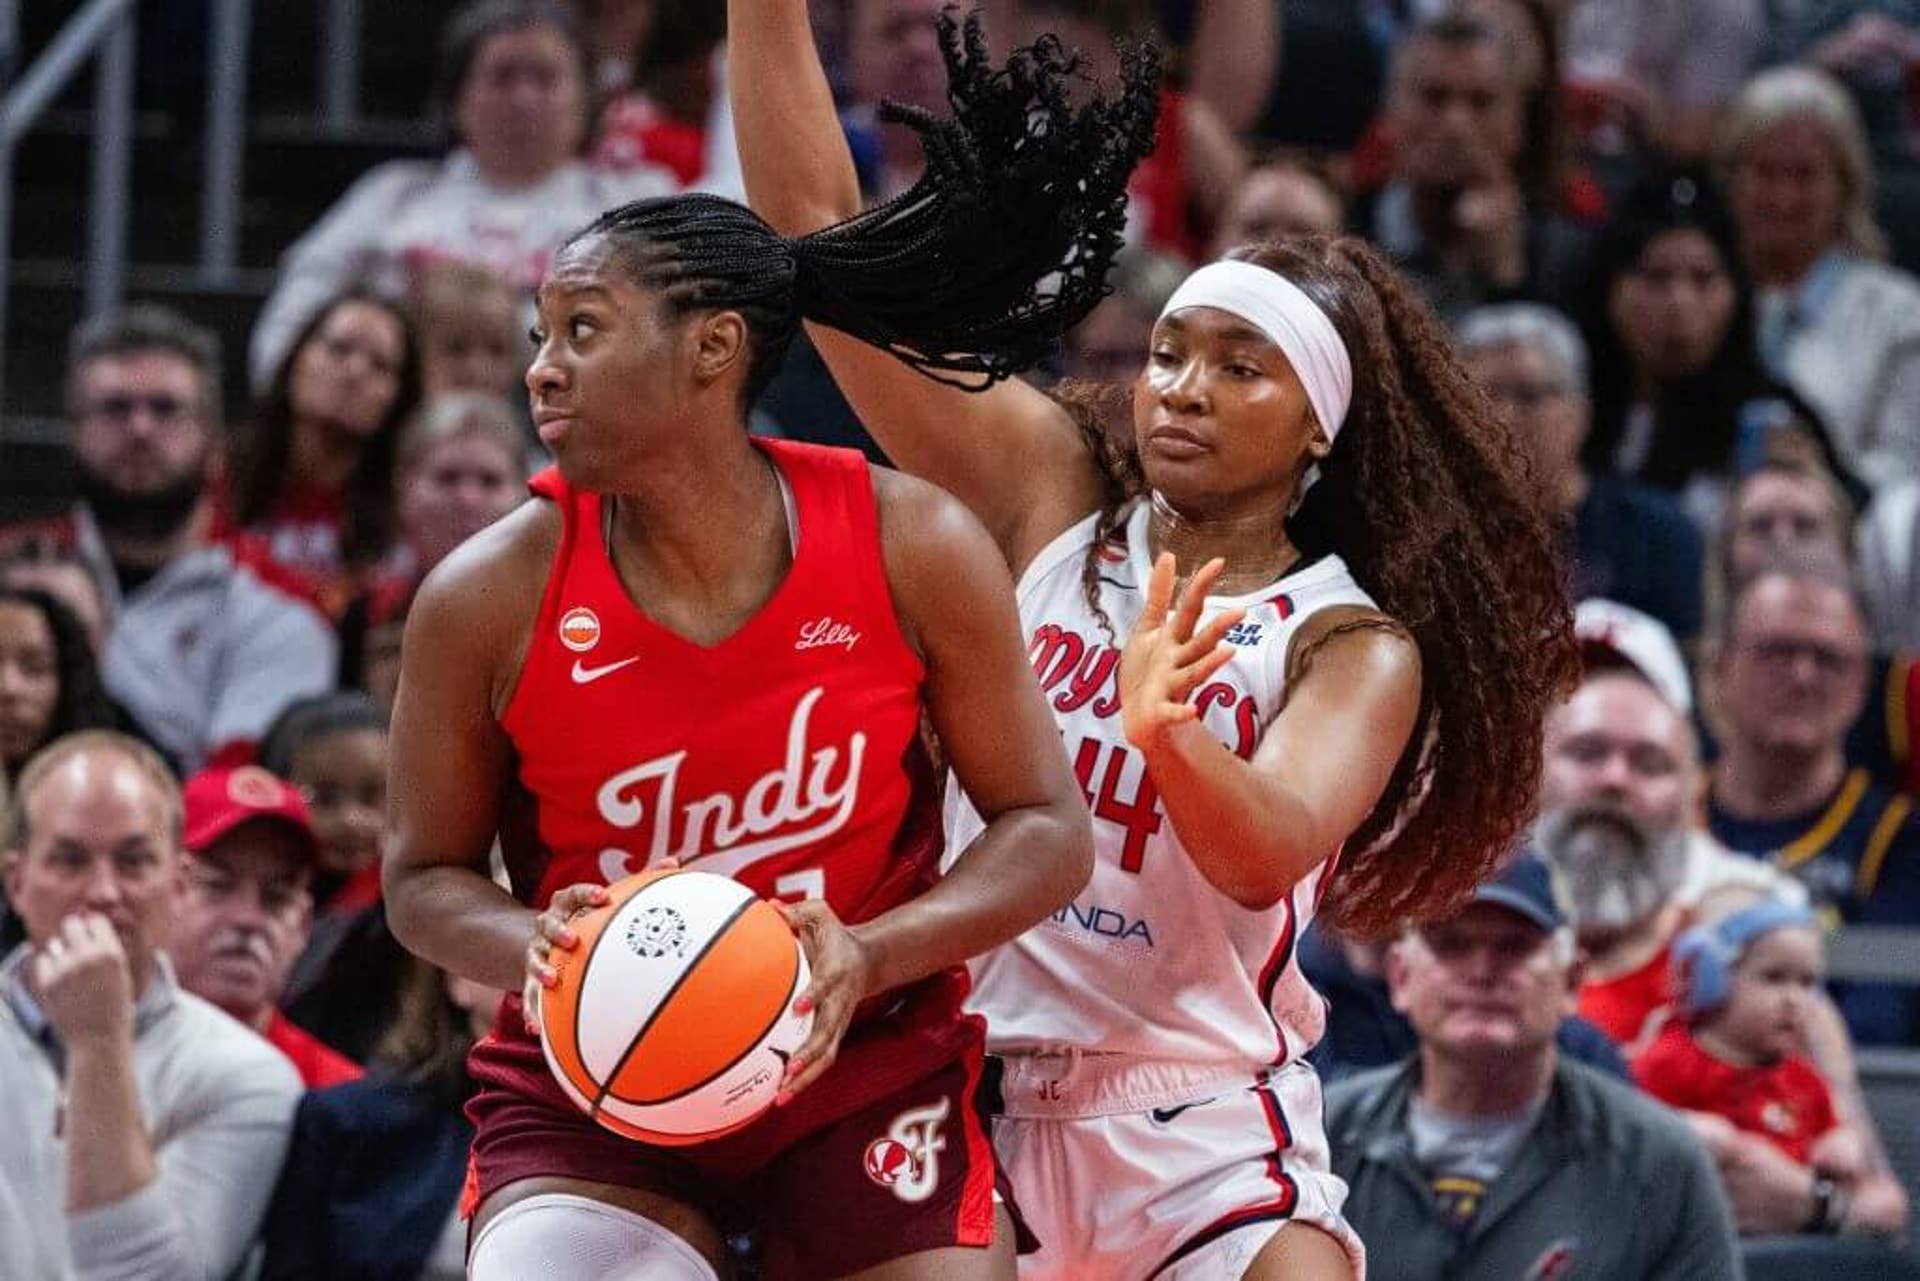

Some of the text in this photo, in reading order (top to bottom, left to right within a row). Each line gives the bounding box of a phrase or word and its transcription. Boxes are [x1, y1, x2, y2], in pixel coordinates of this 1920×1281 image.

[794, 616, 862, 652] Lilly
[596, 683, 867, 885] Indy
[1052, 900, 1154, 948] NDA
